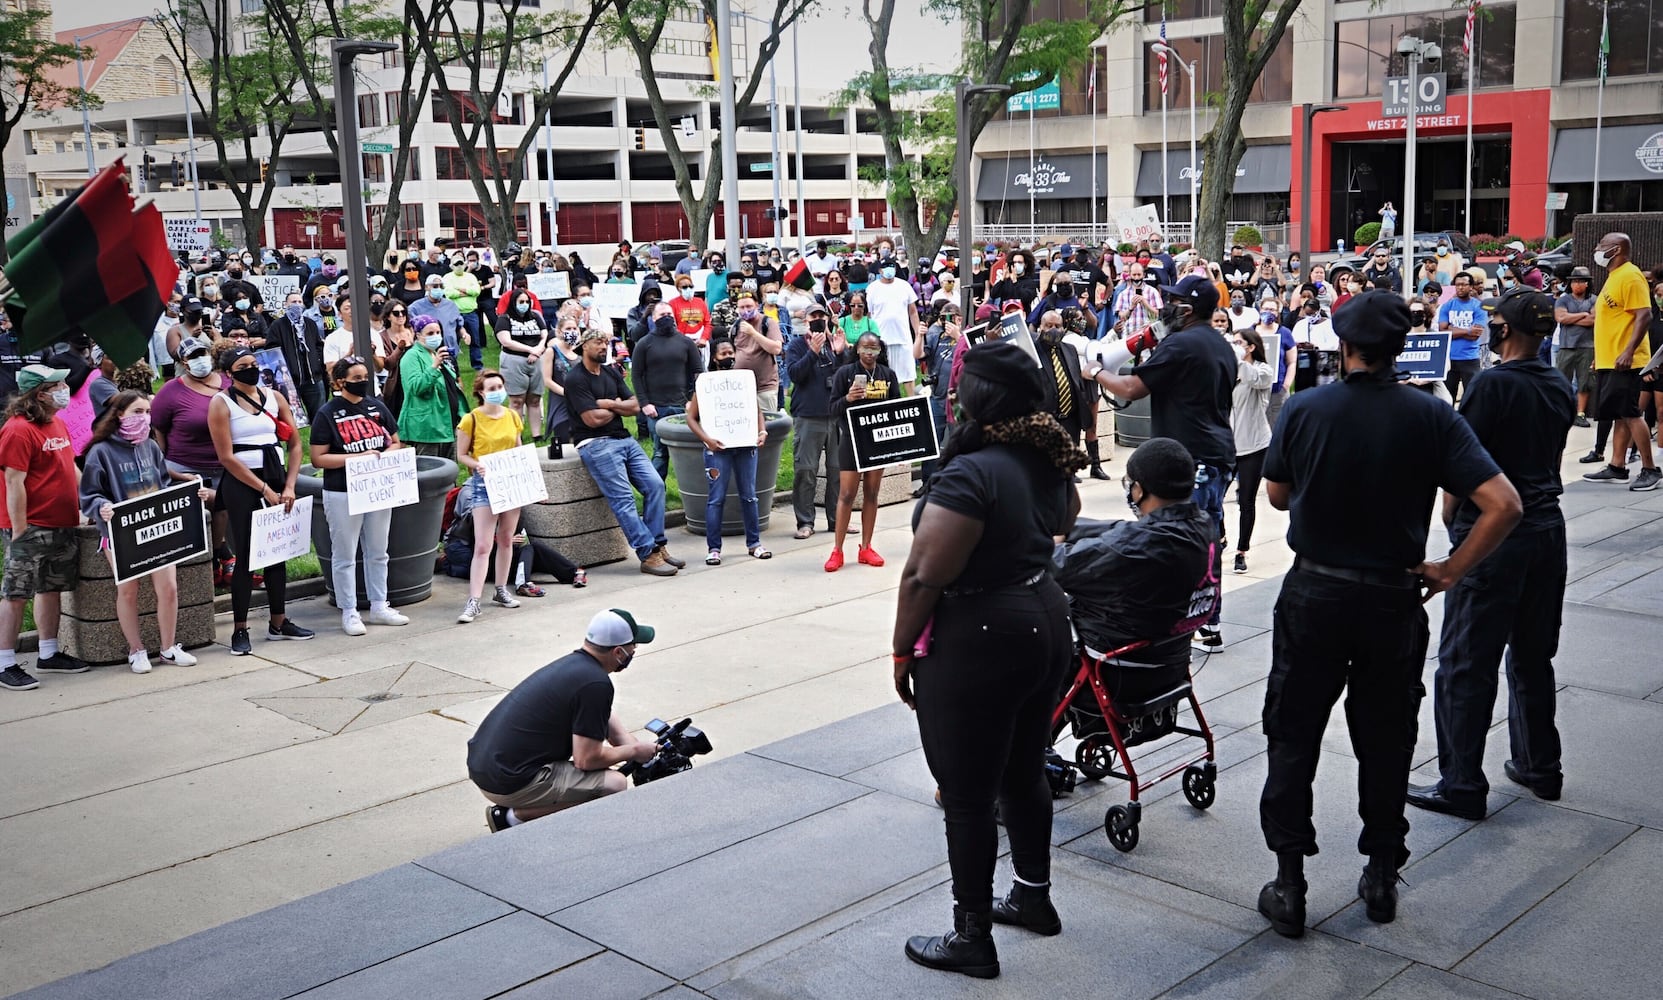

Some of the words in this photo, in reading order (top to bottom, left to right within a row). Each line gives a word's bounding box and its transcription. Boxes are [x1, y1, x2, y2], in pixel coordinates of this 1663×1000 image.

[1388, 76, 1440, 104] 130
[1039, 93, 1058, 103] 2273
[1386, 105, 1442, 115] BUIDING
[1367, 120, 1398, 130] WEST
[1416, 116, 1460, 127] STREET
[1635, 149, 1658, 157] COFFEE
[1035, 172, 1050, 187] 33
[264, 277, 279, 285] NO
[258, 285, 296, 296] USTICE
[1448, 310, 1474, 321] BLACK
[1001, 323, 1019, 338] LIVES
[1417, 340, 1440, 348] LIVES
[705, 378, 744, 393] Justice
[714, 396, 745, 410] Peace
[859, 412, 890, 426] BLACK
[894, 406, 921, 420] LIVES
[714, 415, 752, 434] Equality
[877, 425, 912, 440] MATTER
[343, 441, 364, 453] NOT
[349, 453, 400, 474] REVOLUTION
[401, 452, 411, 464] IS
[350, 478, 369, 494] NOT
[372, 478, 378, 487] A
[380, 473, 395, 486] ONE
[398, 469, 417, 481] TIME
[369, 486, 396, 503] EVENT
[121, 507, 156, 528] BLACK
[162, 495, 192, 514] LIVES
[140, 519, 179, 541] MATTER
[266, 521, 301, 544] AMERICAN
